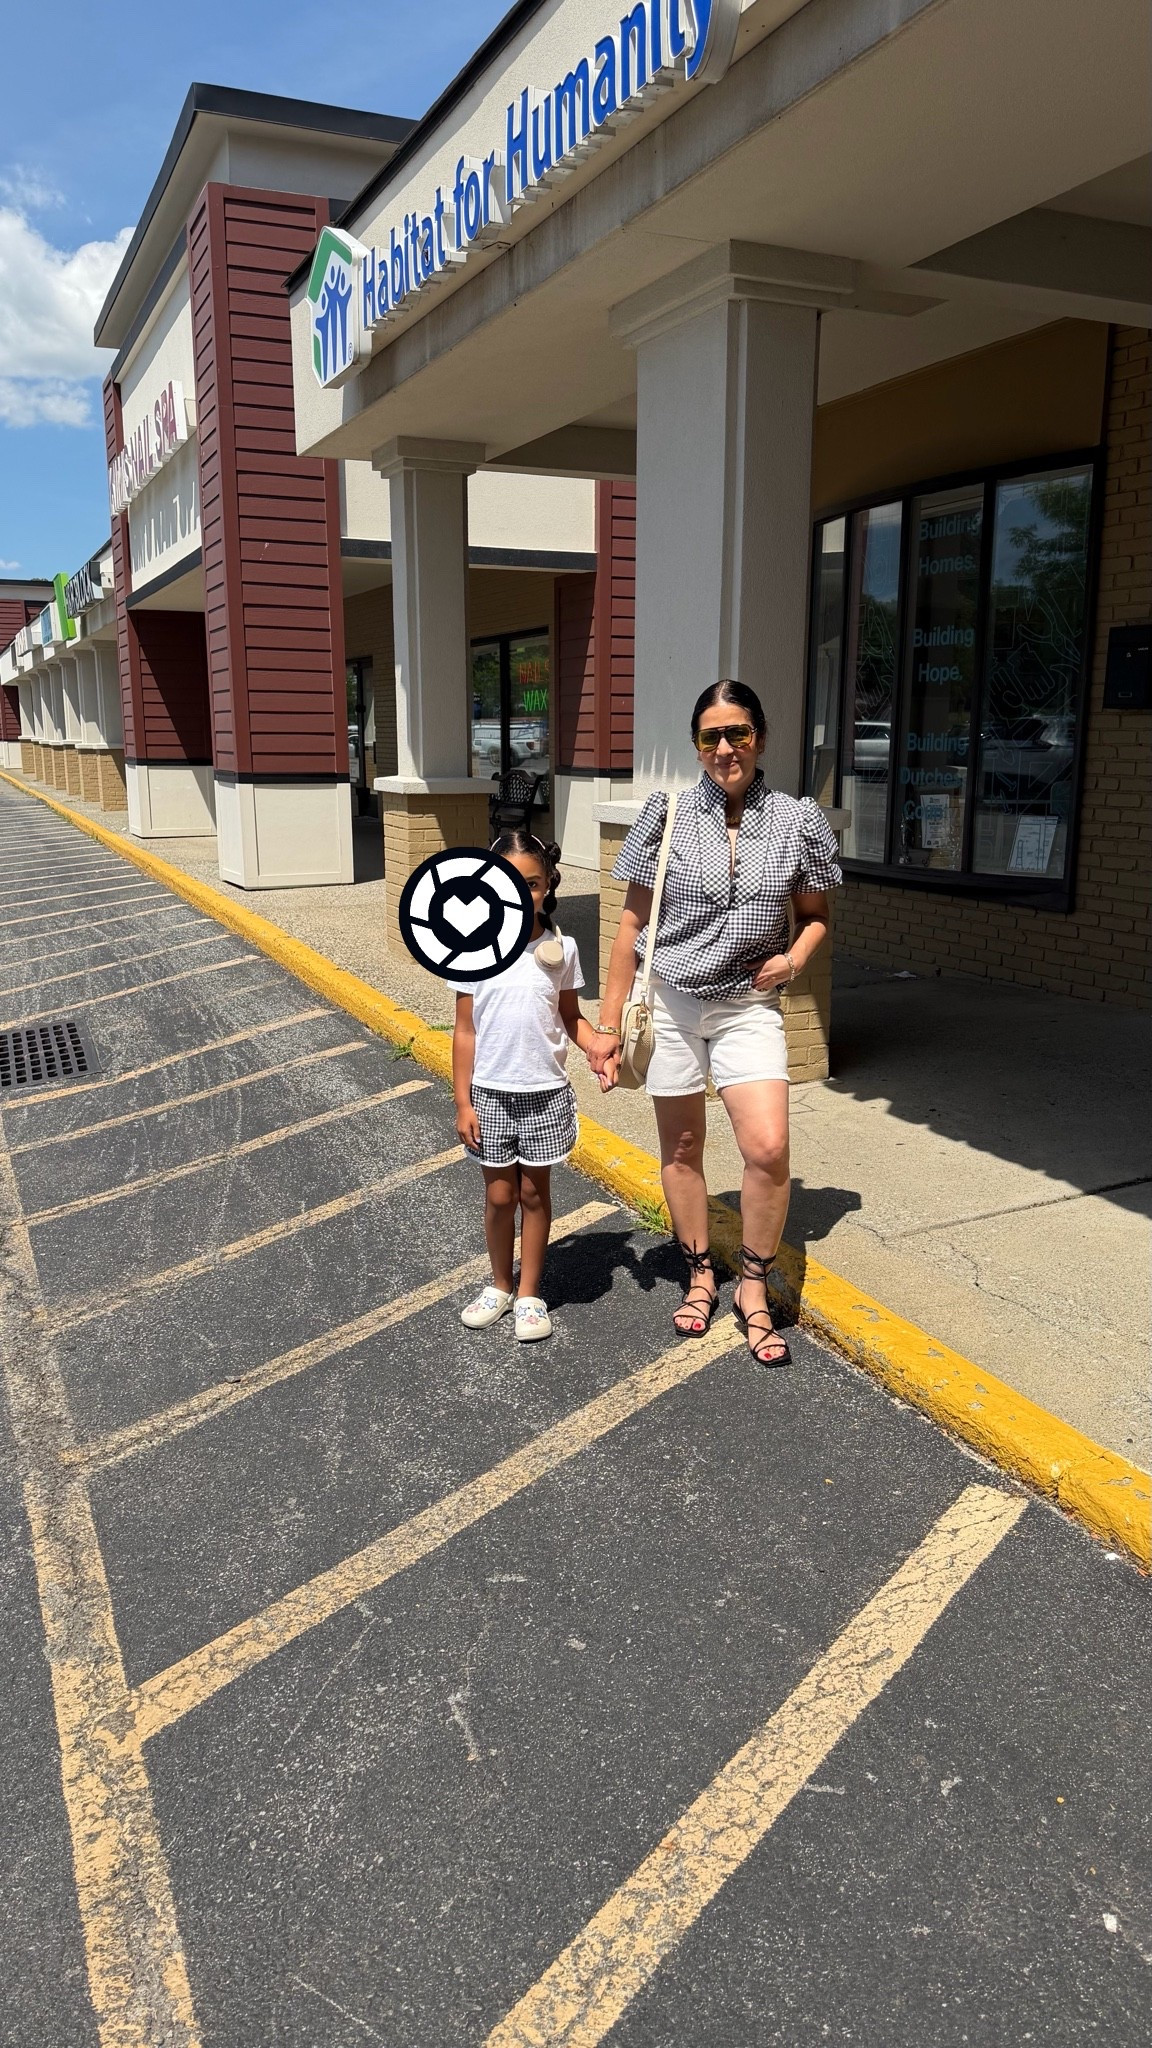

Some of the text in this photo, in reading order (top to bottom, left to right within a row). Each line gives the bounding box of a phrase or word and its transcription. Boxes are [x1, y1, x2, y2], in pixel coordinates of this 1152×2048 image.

[363, 185, 447, 331] Habitat
[453, 149, 496, 252] for
[129, 414, 154, 491] NAIL
[154, 379, 180, 462] SPA
[919, 514, 980, 541] Building
[912, 624, 975, 648] Building
[523, 688, 548, 712] WAX
[906, 732, 969, 756] Building
[900, 766, 966, 788] Dutches
